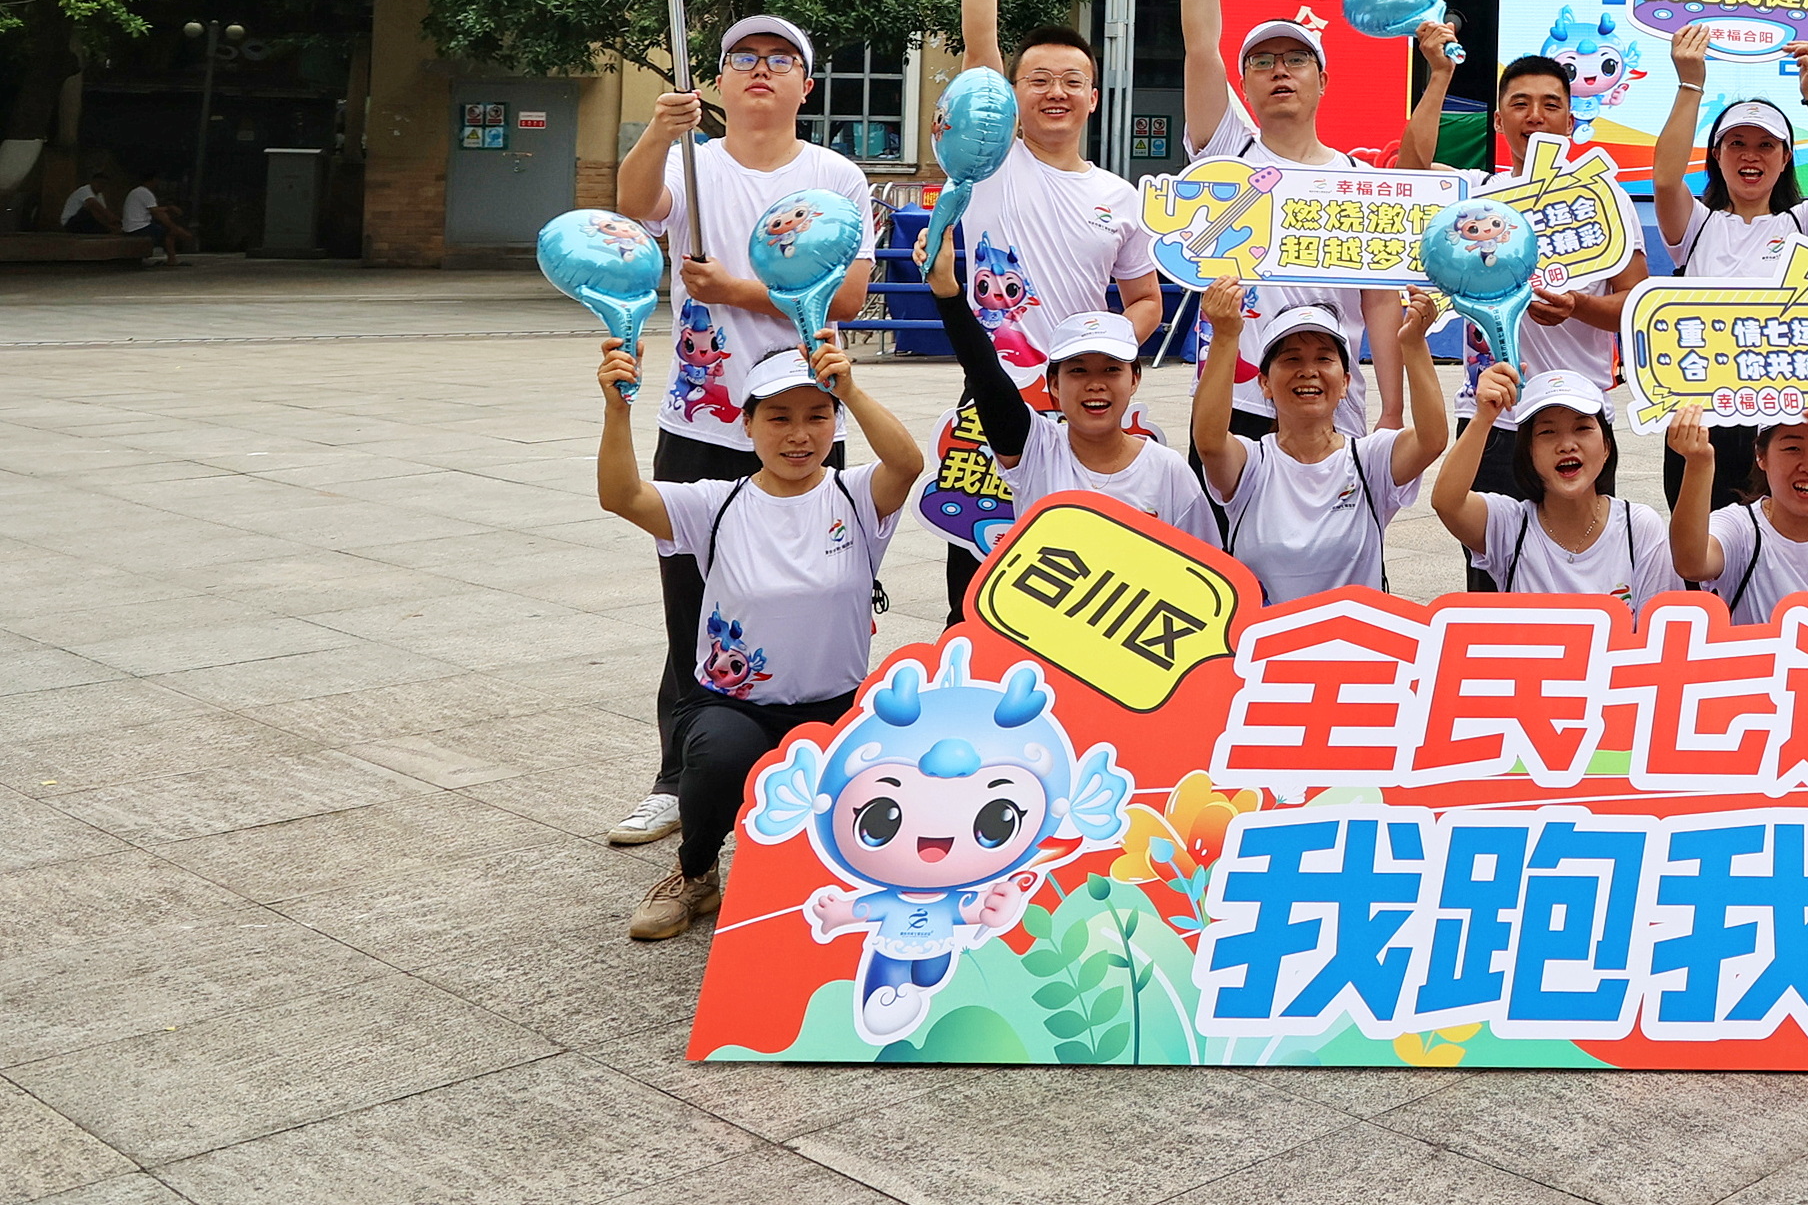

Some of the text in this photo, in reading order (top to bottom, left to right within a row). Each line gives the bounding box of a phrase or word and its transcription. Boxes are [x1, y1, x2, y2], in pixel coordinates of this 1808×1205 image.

[1711, 28, 1774, 44] 幸福合阳
[1336, 180, 1413, 198] 幸福合阳
[1280, 199, 1444, 235] 燃烧激情
[1717, 392, 1801, 413] 幸福合阳
[1011, 546, 1207, 672] 合川区
